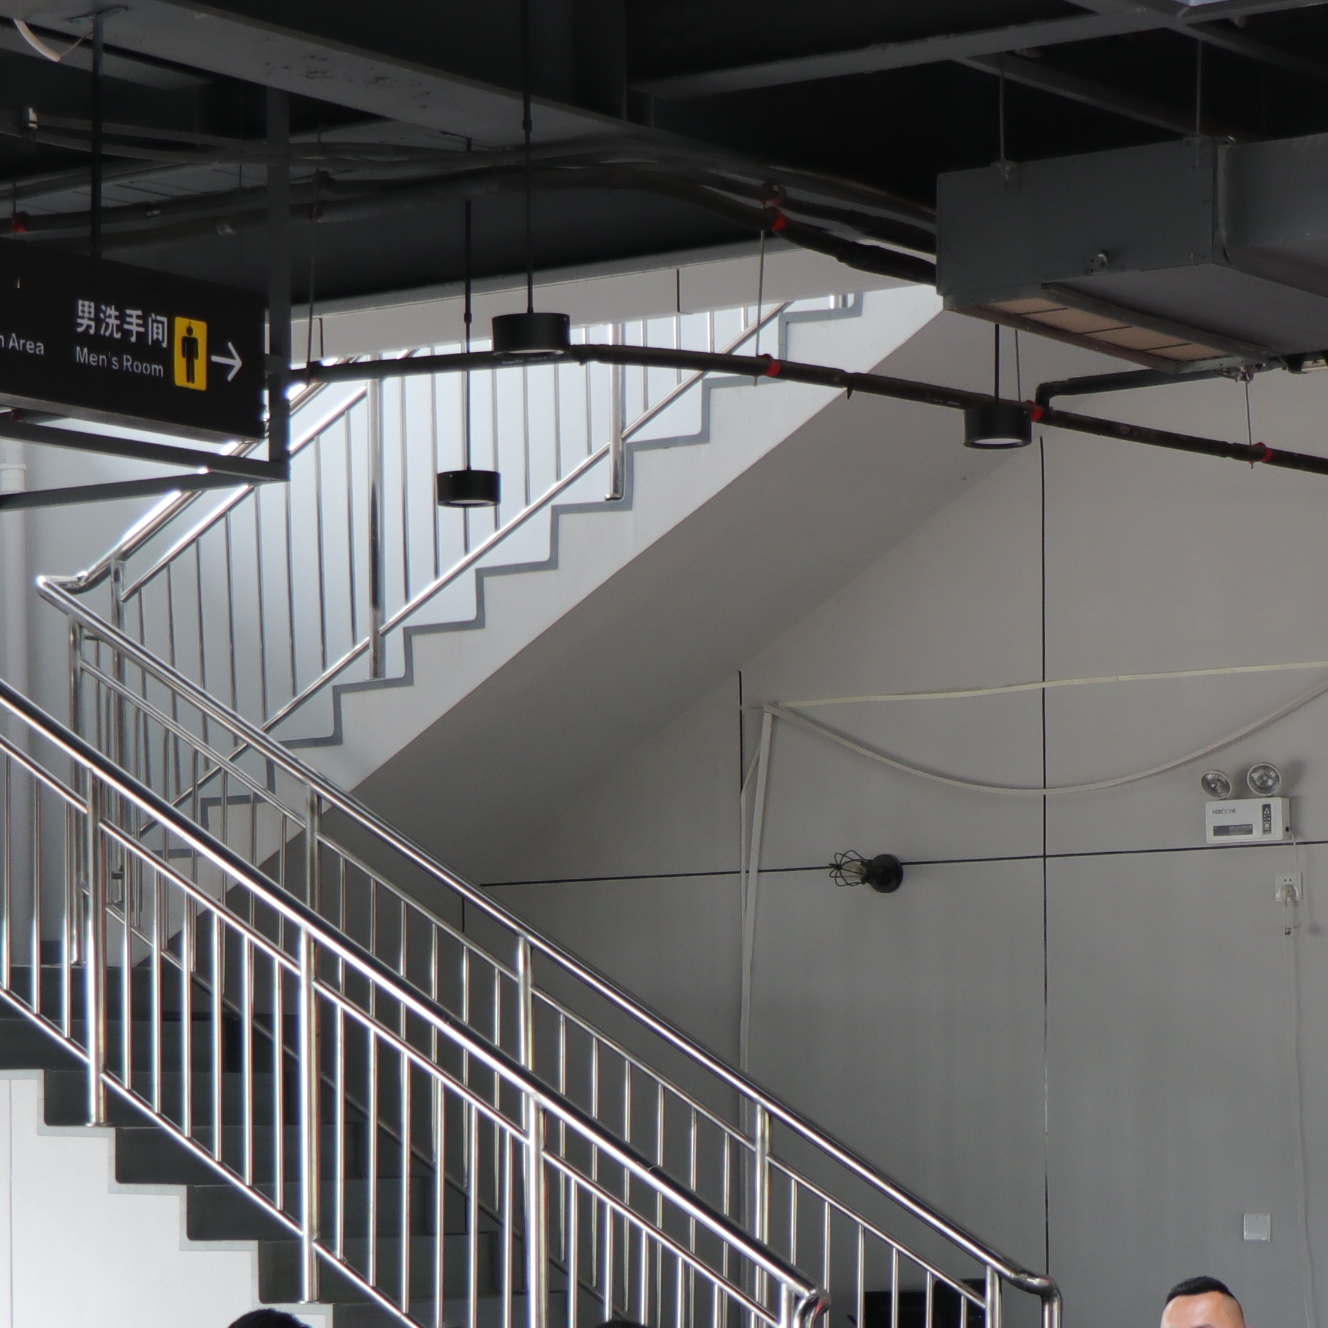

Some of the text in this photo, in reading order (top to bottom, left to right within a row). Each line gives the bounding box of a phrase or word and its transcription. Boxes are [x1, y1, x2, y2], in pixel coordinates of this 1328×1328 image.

[76, 299, 168, 348] 男洗手间
[8, 332, 45, 356] Area
[75, 345, 164, 378] Men's Room
